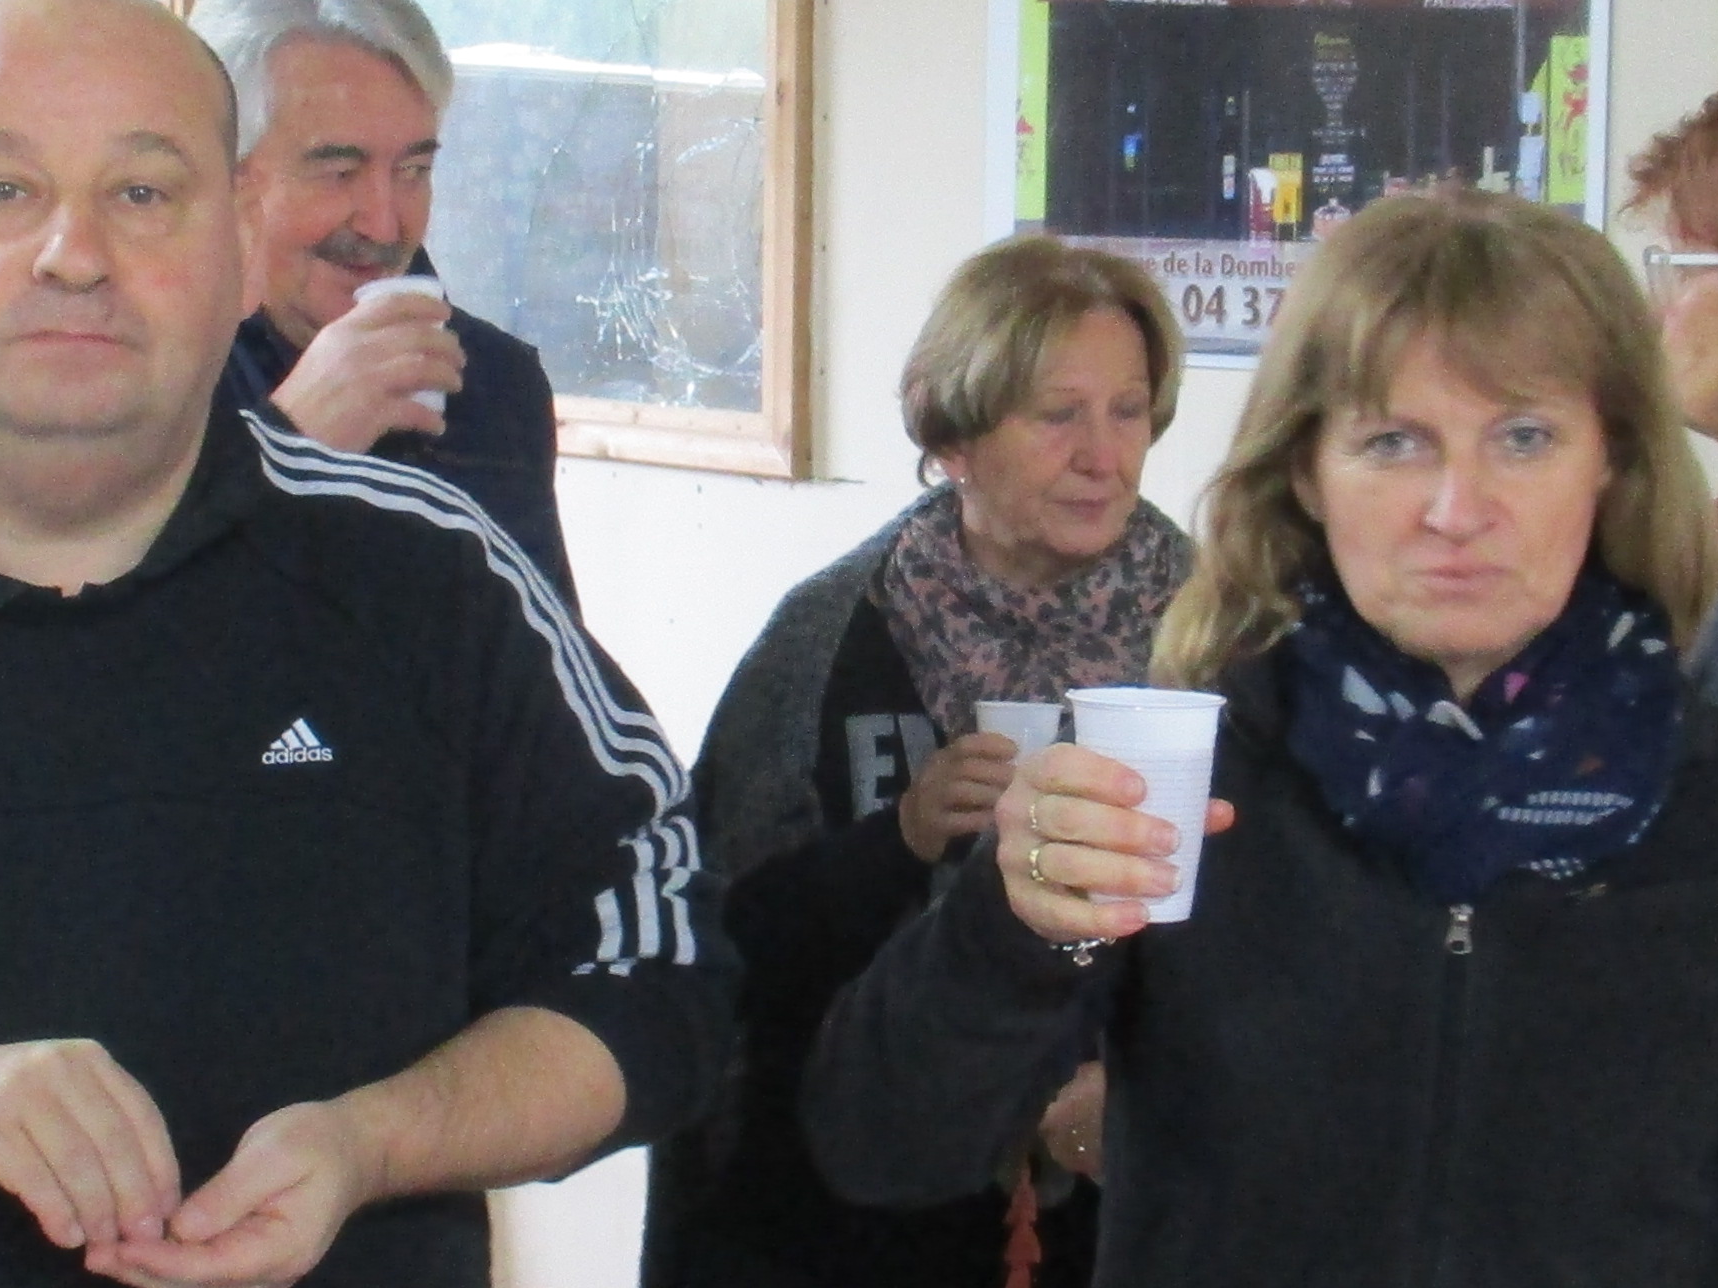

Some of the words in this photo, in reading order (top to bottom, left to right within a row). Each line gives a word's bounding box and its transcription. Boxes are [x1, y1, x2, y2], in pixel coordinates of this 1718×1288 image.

[1163, 251, 1187, 274] de
[1195, 252, 1213, 275] la
[1221, 253, 1297, 278] Dombe
[1183, 284, 1227, 326] 04
[261, 746, 333, 765] adidas
